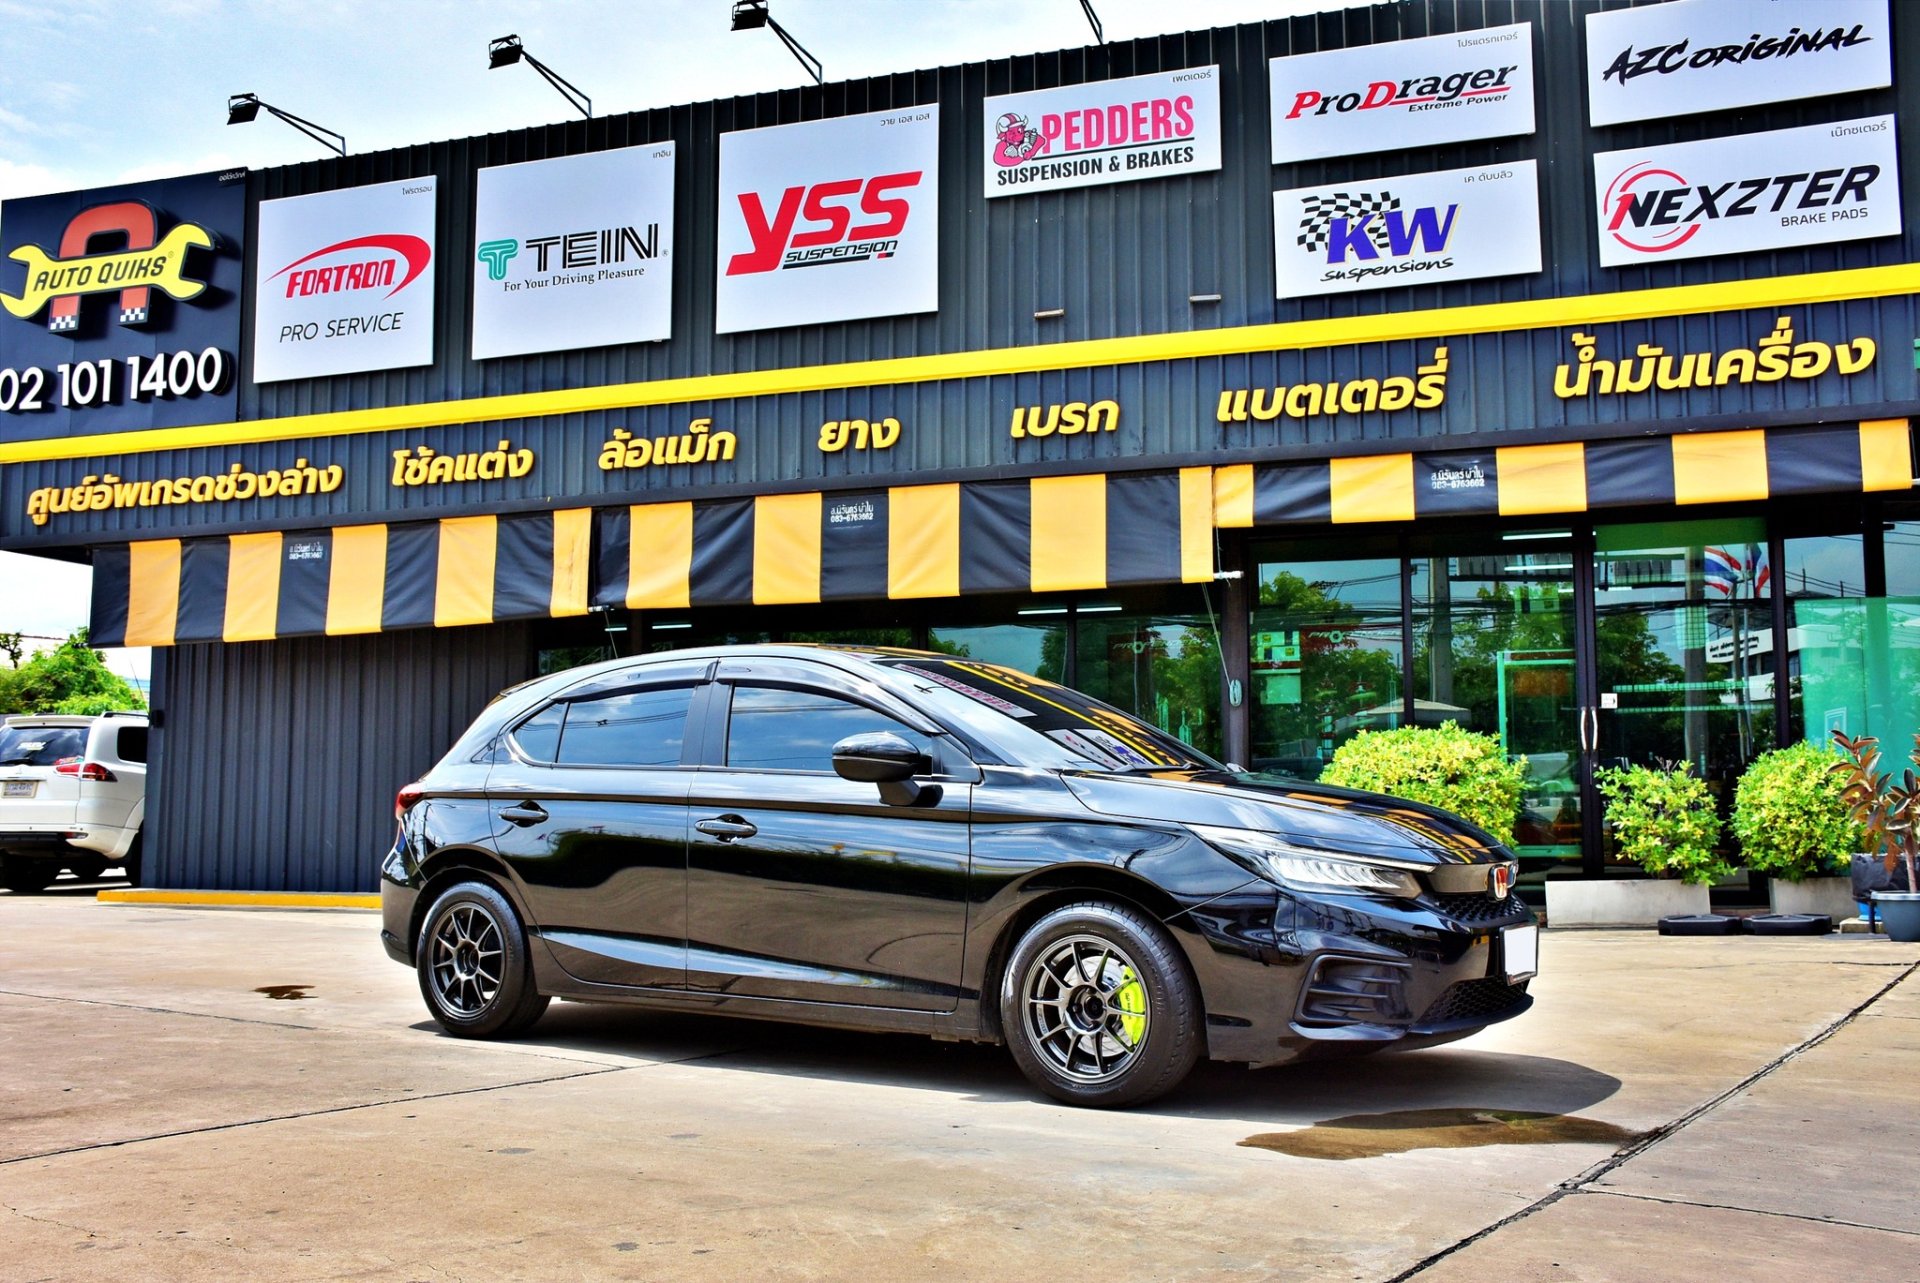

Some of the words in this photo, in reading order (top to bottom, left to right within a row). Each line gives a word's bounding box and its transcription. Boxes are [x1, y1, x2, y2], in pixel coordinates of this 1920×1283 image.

[1603, 38, 1689, 86] AZC
[1285, 65, 1518, 119] ProDrager
[1408, 101, 1463, 113] Extreme
[1466, 93, 1508, 106] Power
[1042, 95, 1195, 154] PEDDERS
[997, 158, 1103, 186] SUSPENSION
[1108, 155, 1120, 172] &
[1126, 146, 1194, 170] BRAKES
[1607, 164, 1880, 231] NEXZTER
[1781, 212, 1827, 227] BRAKE
[1832, 207, 1868, 221] PADS
[726, 171, 923, 276] YSS
[1327, 203, 1460, 264] KW
[525, 223, 659, 273] TEIN
[785, 240, 898, 263] SUSPENSION
[1320, 257, 1454, 282] suspensions
[33, 265, 93, 292] AUTO
[286, 258, 396, 298] FORTRON
[503, 281, 521, 292] For
[524, 279, 550, 291] Your
[552, 272, 595, 286] Driving
[598, 267, 645, 281] Pleasure
[279, 322, 319, 343] PRO
[325, 311, 404, 338] SERVICE
[0, 366, 44, 411] 02
[57, 360, 113, 406] 101
[127, 346, 222, 399] 1400
[1553, 316, 1877, 399] น้ำมันเครื่อง
[1215, 346, 1450, 424] แบตเตอรี่
[817, 416, 901, 453] ยาง
[1009, 398, 1120, 440] เบรก
[391, 440, 535, 487] โช้คแต่ง
[597, 418, 737, 471] ล้อแม็ก
[26, 458, 344, 526] ศูนย์อัพเกรดช่วงล่าง
